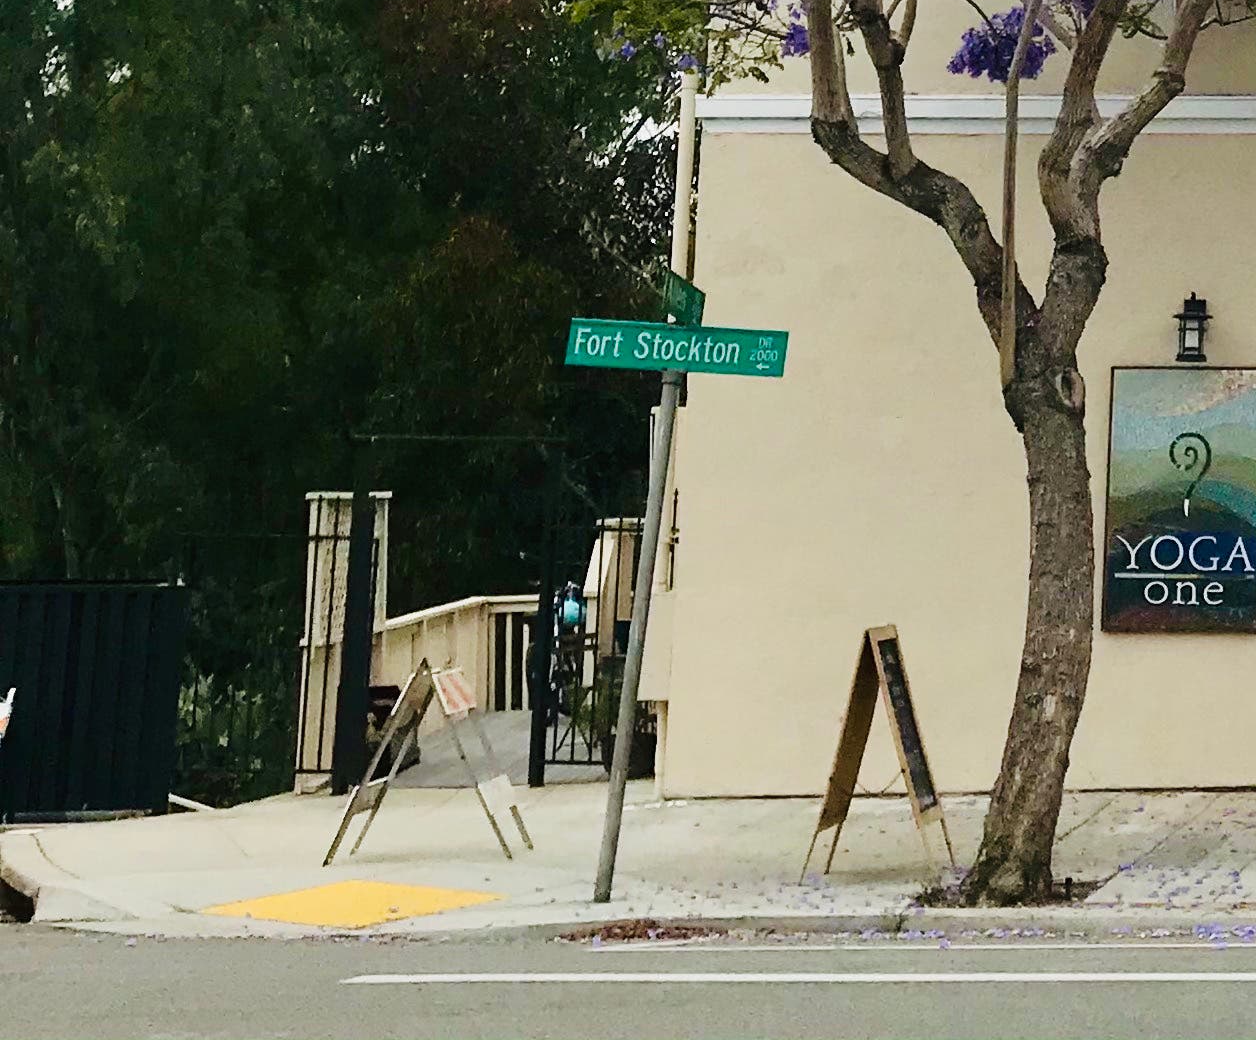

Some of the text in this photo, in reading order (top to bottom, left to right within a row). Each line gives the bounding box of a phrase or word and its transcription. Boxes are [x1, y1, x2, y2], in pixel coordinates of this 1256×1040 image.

[574, 327, 740, 364] Fort Stockton
[749, 349, 778, 361] 2000
[1116, 535, 1255, 572] YOGA
[1144, 580, 1224, 605] one
